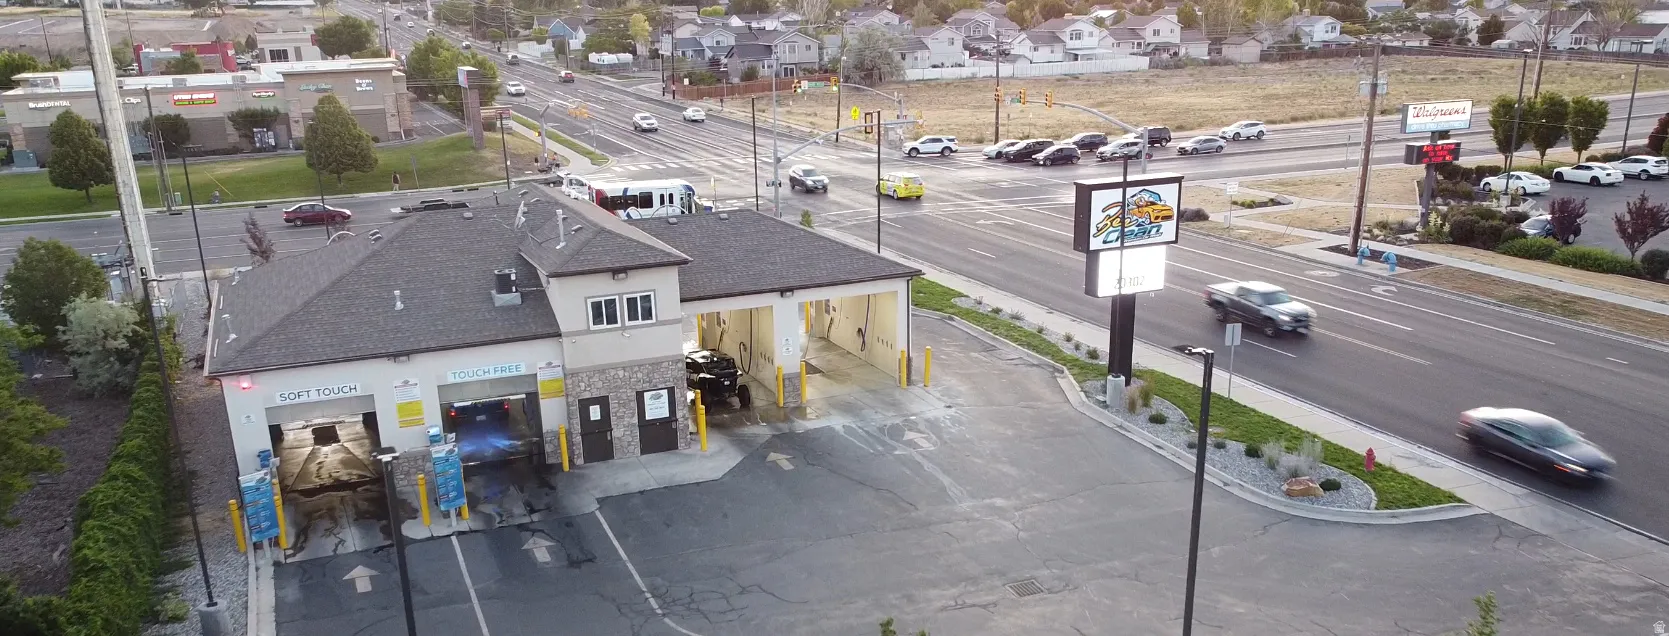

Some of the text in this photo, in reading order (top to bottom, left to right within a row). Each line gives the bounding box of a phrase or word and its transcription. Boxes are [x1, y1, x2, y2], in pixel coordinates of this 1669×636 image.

[28, 100, 71, 109] BrushDENTAL
[1412, 105, 1467, 121] Walgreens
[1093, 201, 1139, 238] Bee
[1113, 275, 1145, 290] 20302
[451, 365, 491, 380] TOUCH
[493, 363, 522, 375] FREE
[279, 384, 358, 402] SOFT TOUCH
